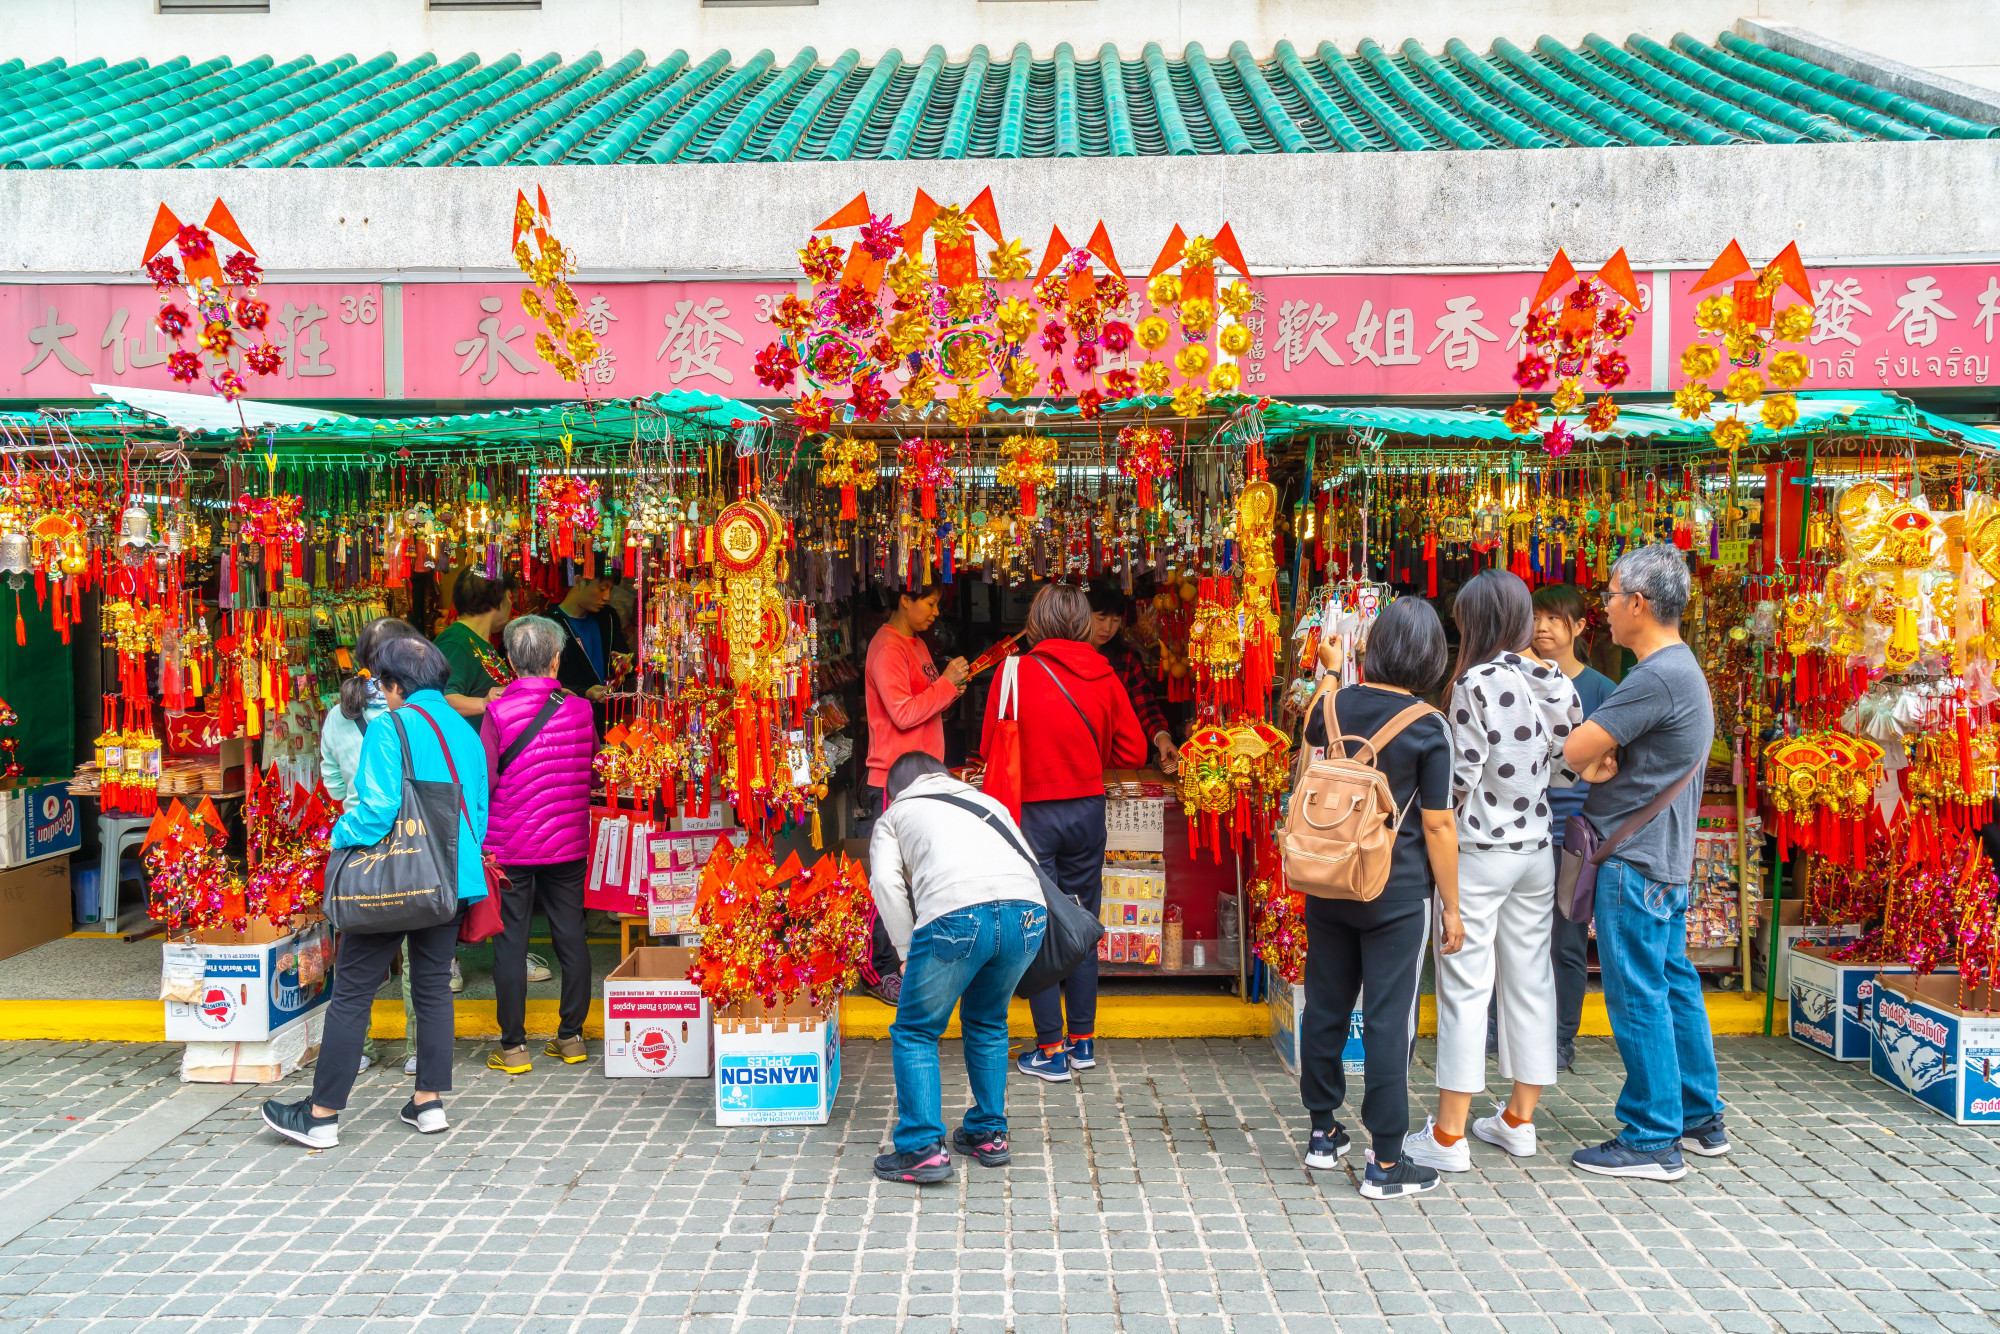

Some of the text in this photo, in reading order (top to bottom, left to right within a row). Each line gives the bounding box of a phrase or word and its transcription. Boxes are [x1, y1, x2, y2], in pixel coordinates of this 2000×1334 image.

[340, 296, 377, 324] 36
[454, 296, 745, 386] 永 發
[176, 723, 245, 748] 大仙
[35, 797, 75, 843] Cascadian
[347, 839, 422, 875] Sigture
[380, 891, 407, 900] Chocolate
[406, 887, 436, 897] Experience
[218, 964, 242, 973] World's
[243, 964, 257, 973] The
[612, 1002, 697, 1012] The World's Finest Apples
[1880, 1001, 1907, 1026] Apples
[1907, 1018, 1949, 1046] Majestic
[637, 1044, 671, 1053] WASHINGTON
[747, 1056, 792, 1068] APPLES
[721, 1066, 819, 1085] MANSON
[739, 1115, 769, 1123] APPLES
